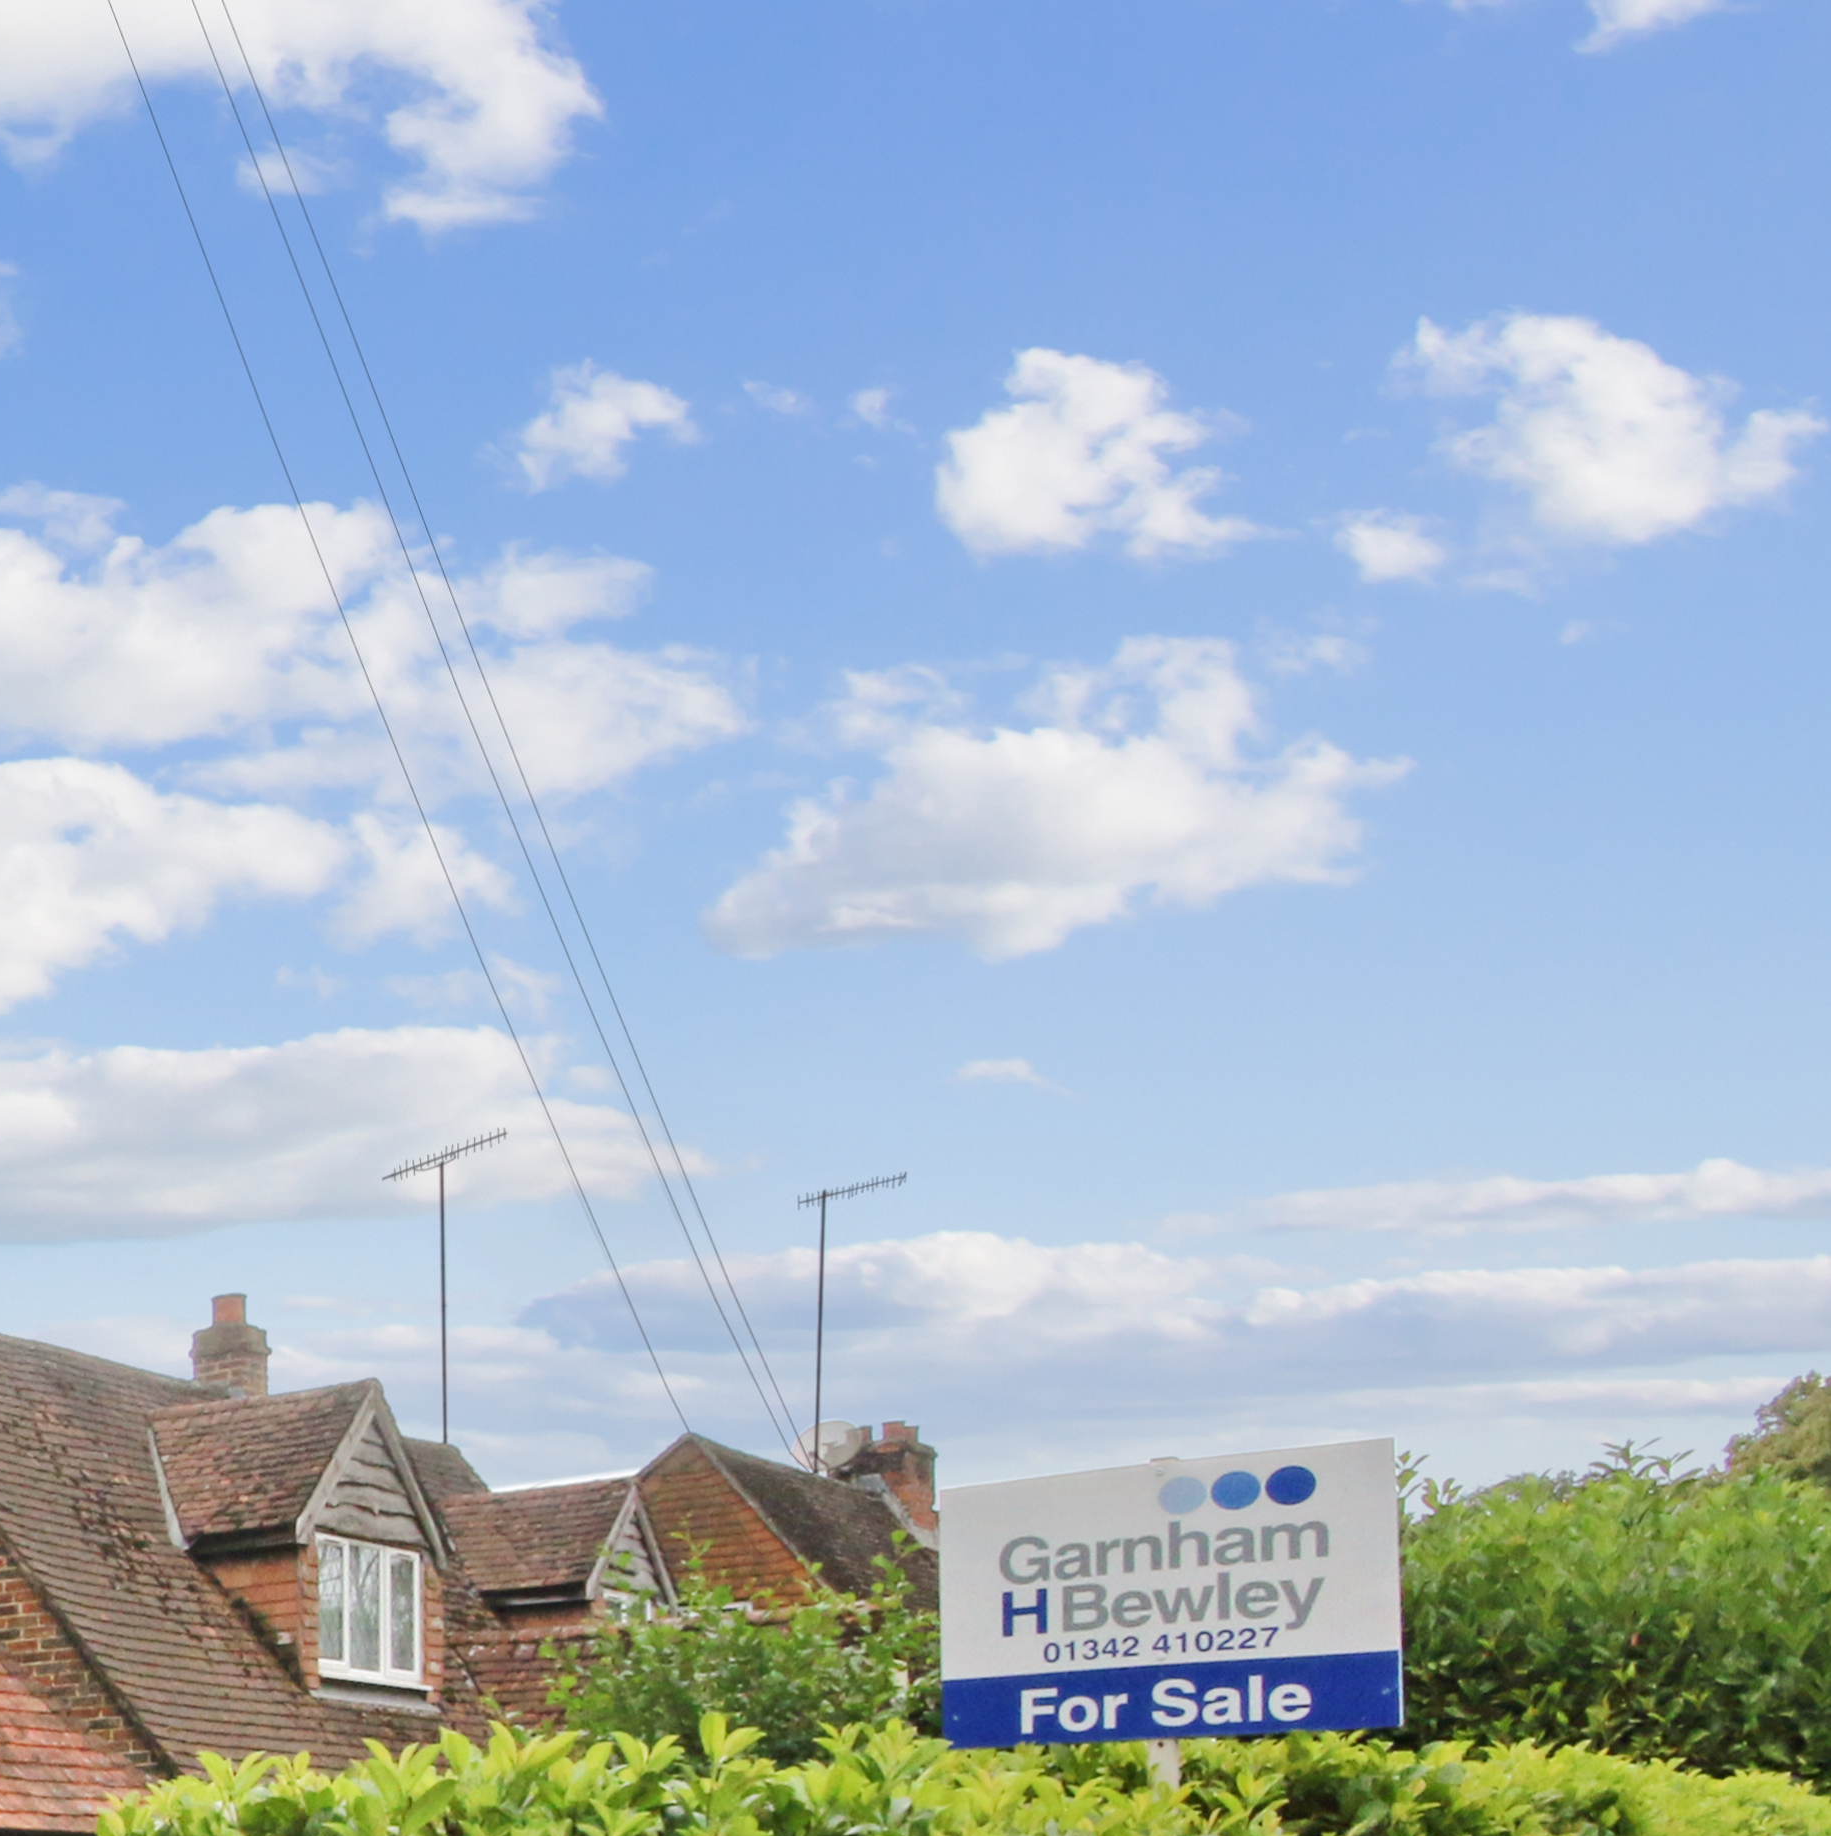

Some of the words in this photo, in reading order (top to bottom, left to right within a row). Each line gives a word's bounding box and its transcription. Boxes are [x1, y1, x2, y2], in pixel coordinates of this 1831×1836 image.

[999, 1520, 1330, 1585] Garnham
[1002, 1589, 1047, 1637] H
[1062, 1572, 1325, 1632] Bewley
[1043, 1636, 1139, 1663] 01342
[1152, 1627, 1280, 1656] 410227
[1020, 1687, 1129, 1735] For
[1151, 1674, 1313, 1727] Sale
